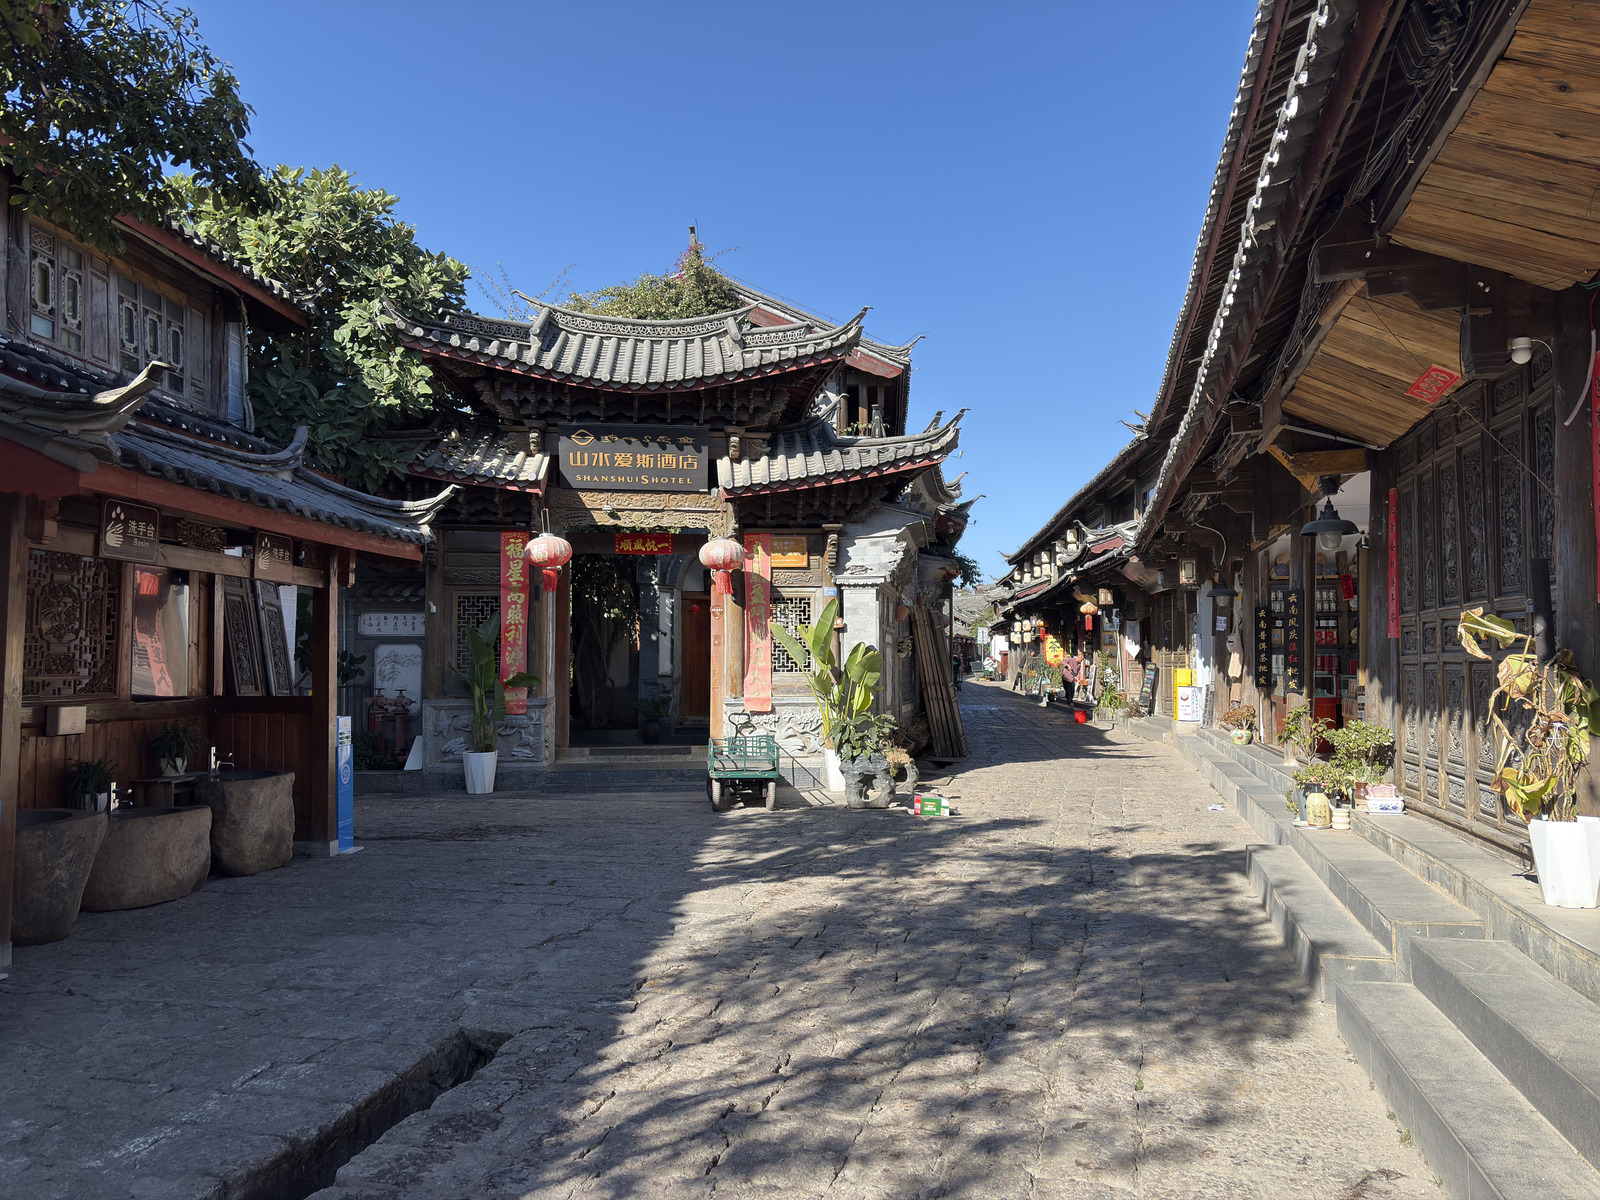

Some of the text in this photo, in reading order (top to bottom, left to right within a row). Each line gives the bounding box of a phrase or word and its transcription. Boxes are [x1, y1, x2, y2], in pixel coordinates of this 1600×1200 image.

[569, 451, 698, 470] 山水爱斯酒店
[128, 520, 155, 538] 洗手台
[133, 538, 150, 547] Basin
[272, 547, 290, 561] 洗手台
[1048, 641, 1060, 654] 茶
[1258, 609, 1268, 685] 云南普洱茶批发
